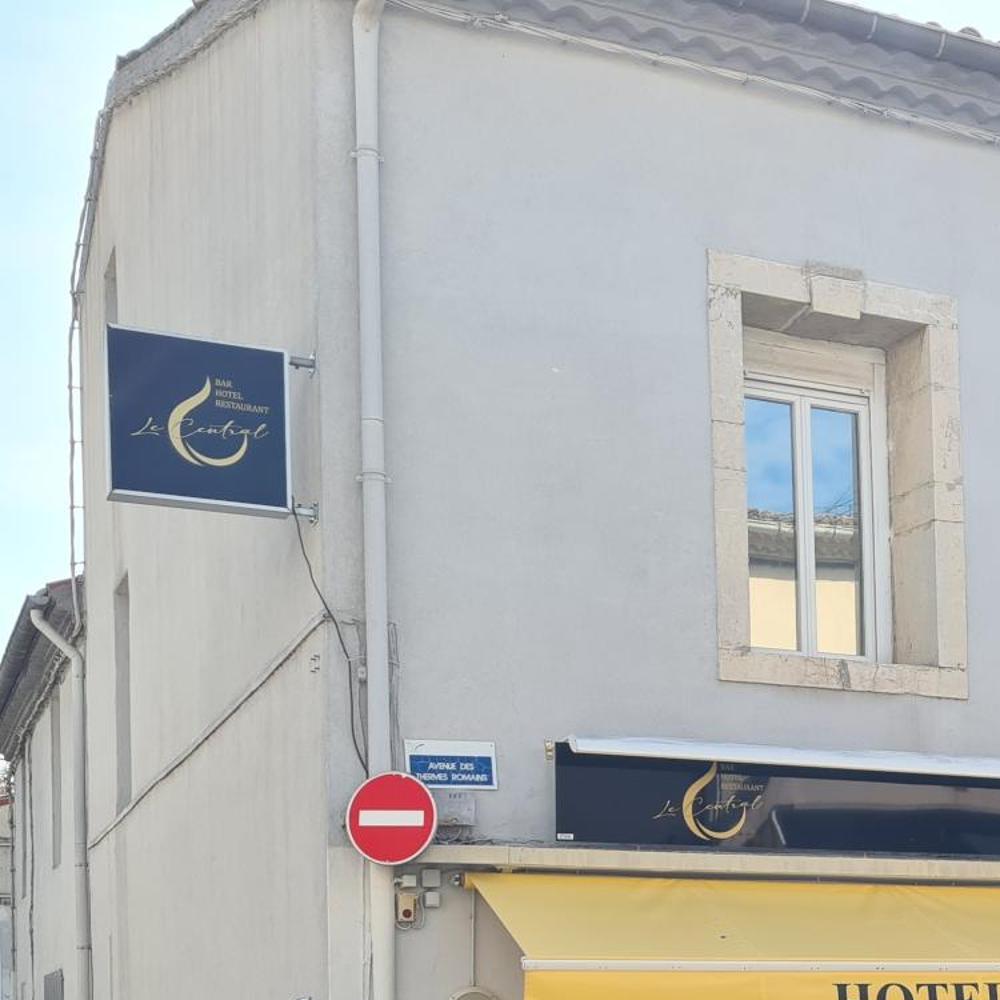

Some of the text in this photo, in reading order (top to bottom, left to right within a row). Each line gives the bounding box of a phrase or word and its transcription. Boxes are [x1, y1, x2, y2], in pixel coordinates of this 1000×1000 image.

[215, 389, 244, 401] HOTEL
[215, 400, 269, 414] RESTAURANT
[428, 761, 475, 771] AVENUE DES
[451, 773, 488, 782] ROMAINS
